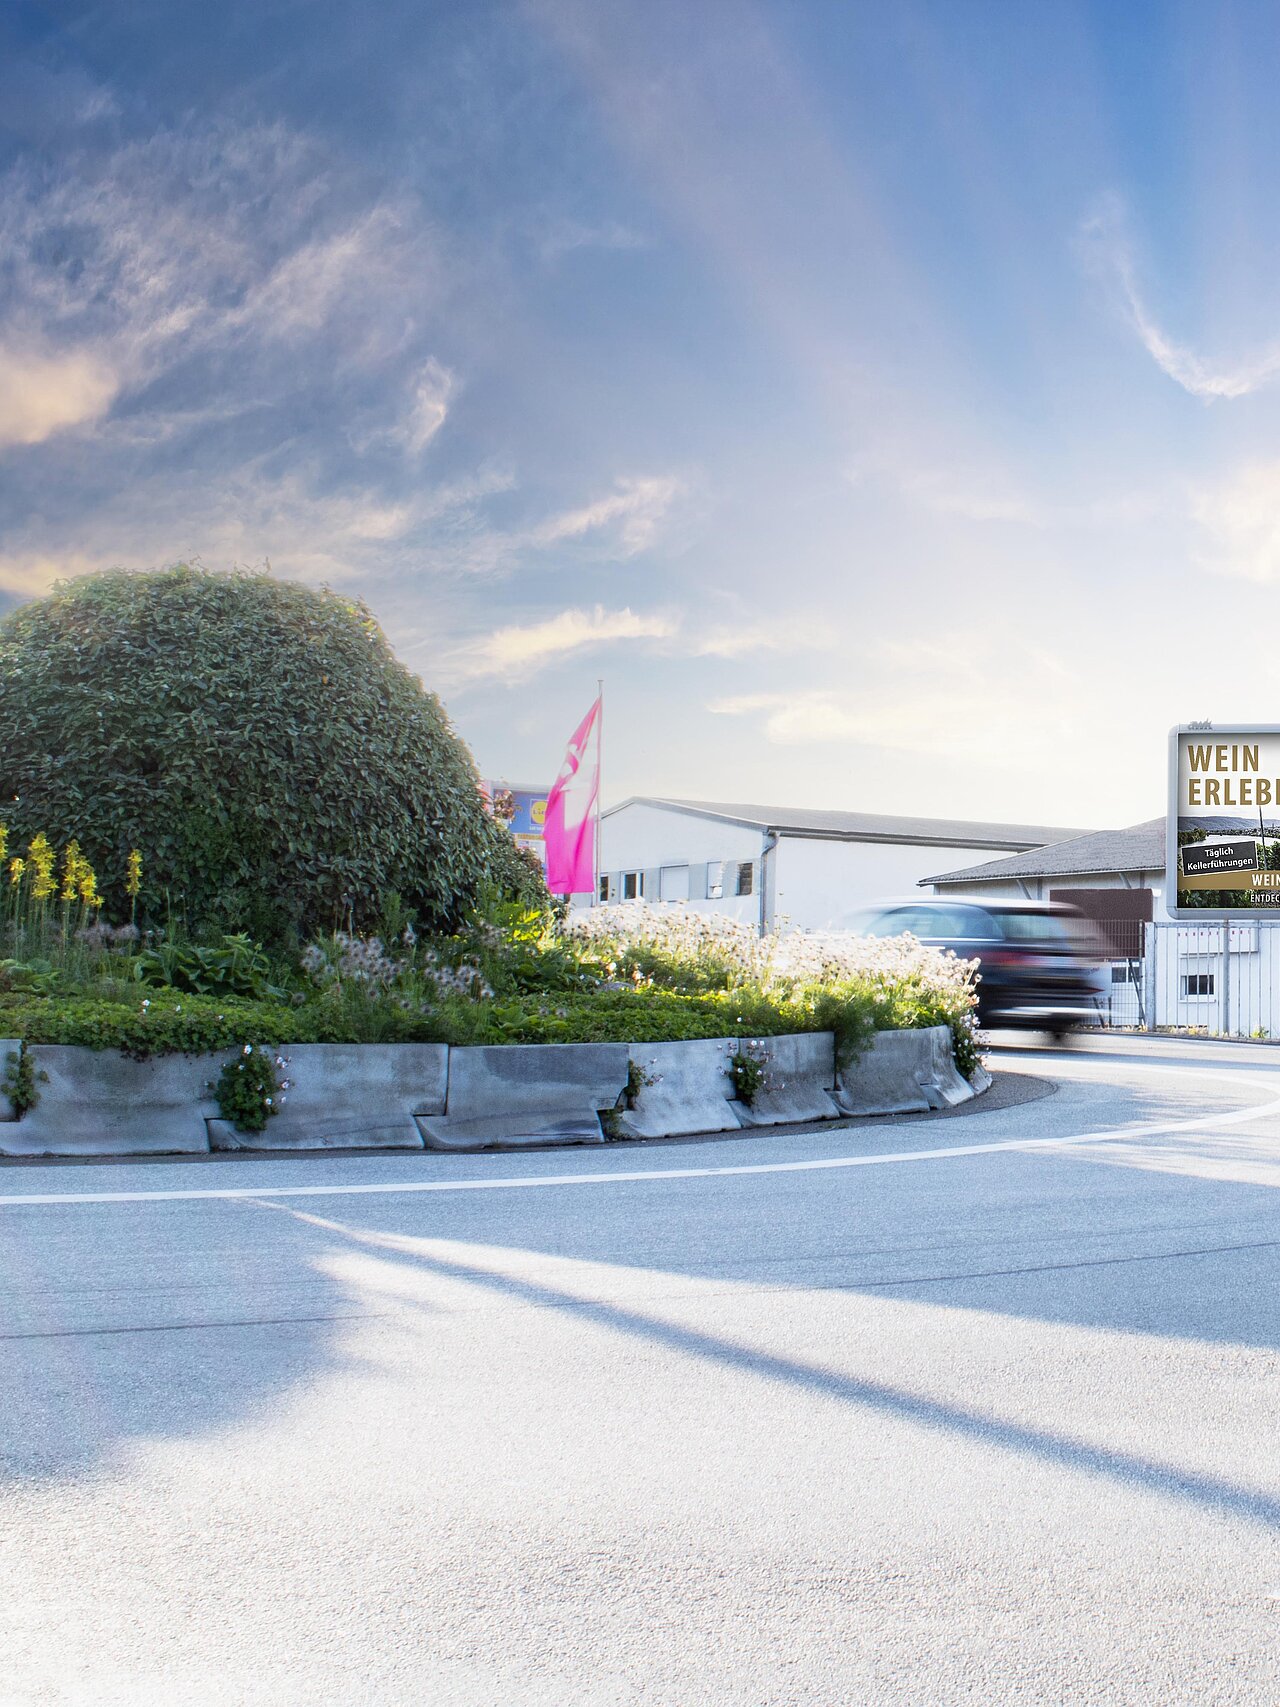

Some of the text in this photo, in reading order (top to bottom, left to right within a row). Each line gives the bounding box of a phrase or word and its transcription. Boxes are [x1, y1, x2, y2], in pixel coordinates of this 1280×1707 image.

[1187, 745, 1259, 771] WEIN
[1205, 847, 1234, 858] Täglich
[1187, 857, 1253, 871] Kellerführungen
